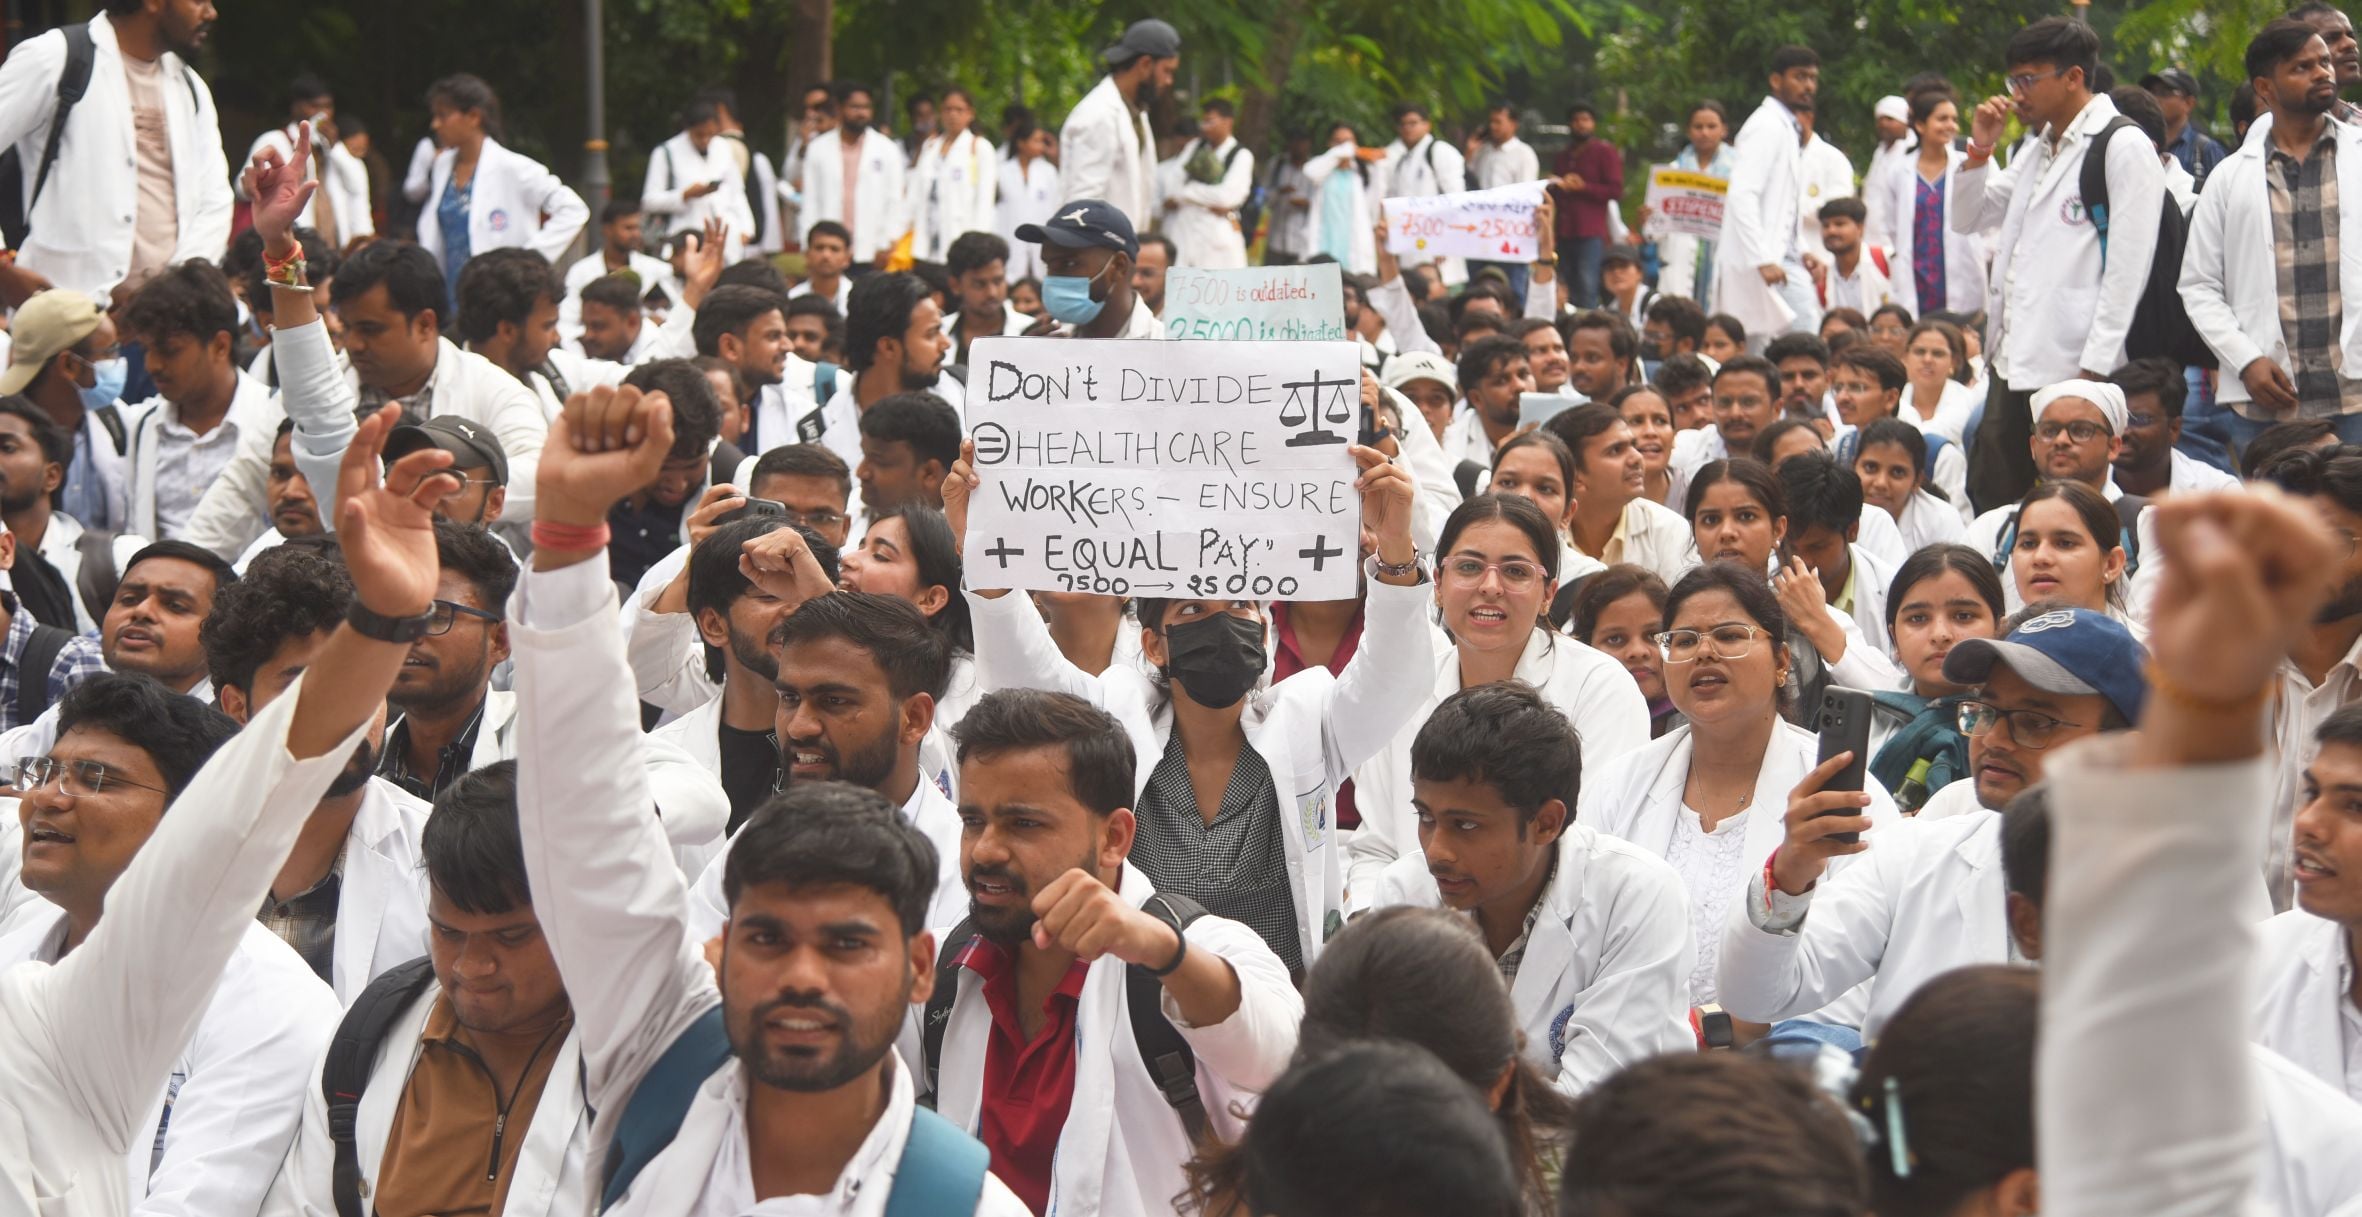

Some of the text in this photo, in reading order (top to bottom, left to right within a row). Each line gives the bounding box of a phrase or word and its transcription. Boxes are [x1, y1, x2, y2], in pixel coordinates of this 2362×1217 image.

[1401, 212, 1444, 237] 7500
[1172, 276, 1229, 305] 7500
[1236, 286, 1246, 302] is
[1121, 367, 1272, 404] DIVIDE
[1199, 480, 1348, 514] ENSURE
[1045, 531, 1178, 579] EQUAL
[1057, 574, 1299, 597] 7500 25000
